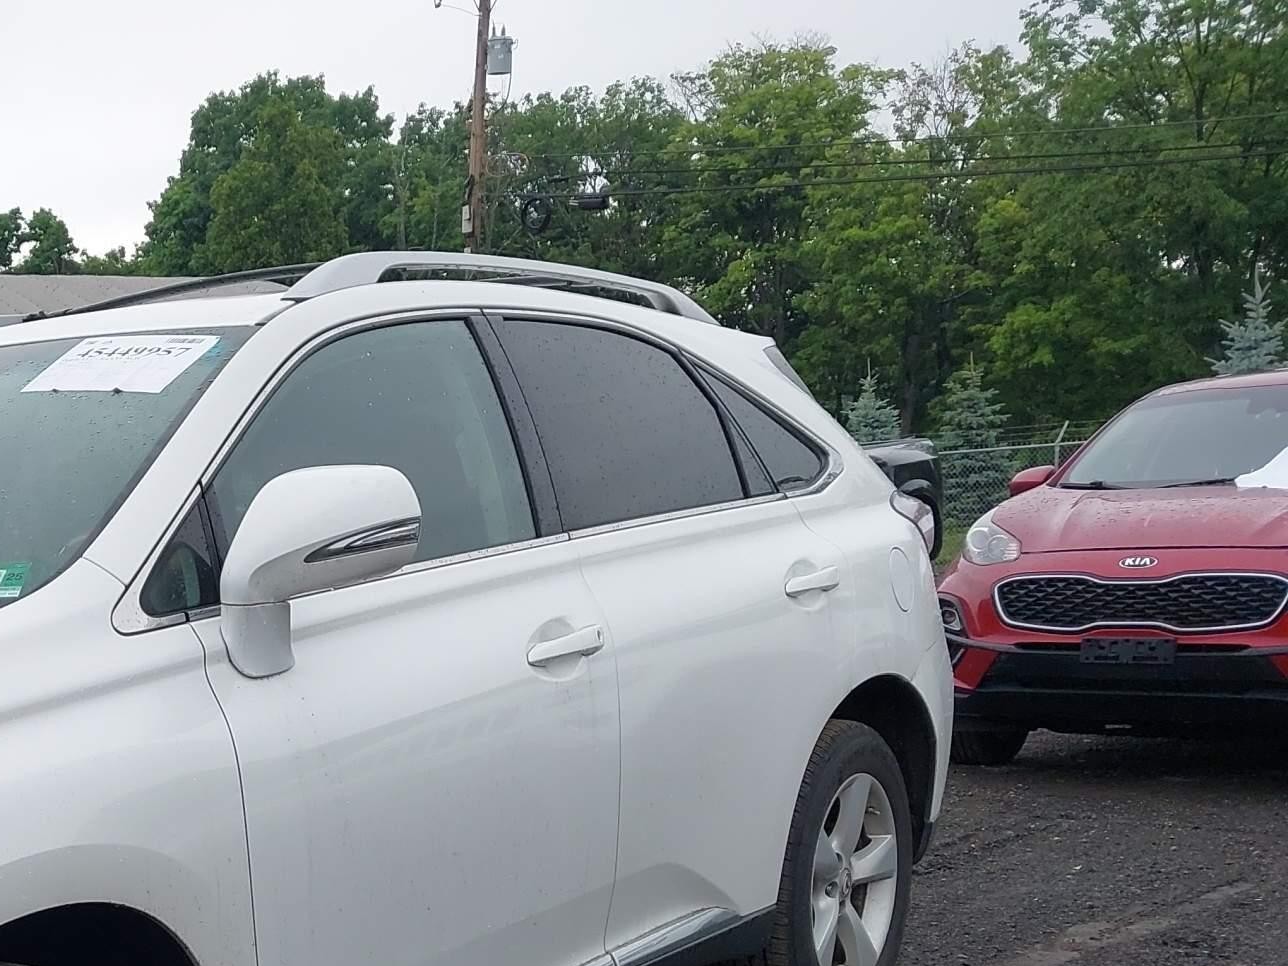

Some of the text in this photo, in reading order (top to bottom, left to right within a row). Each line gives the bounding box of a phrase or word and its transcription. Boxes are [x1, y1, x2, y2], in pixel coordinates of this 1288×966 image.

[77, 346, 193, 358] 45449957
[1124, 557, 1151, 566] KIA
[5, 572, 25, 582] 25
